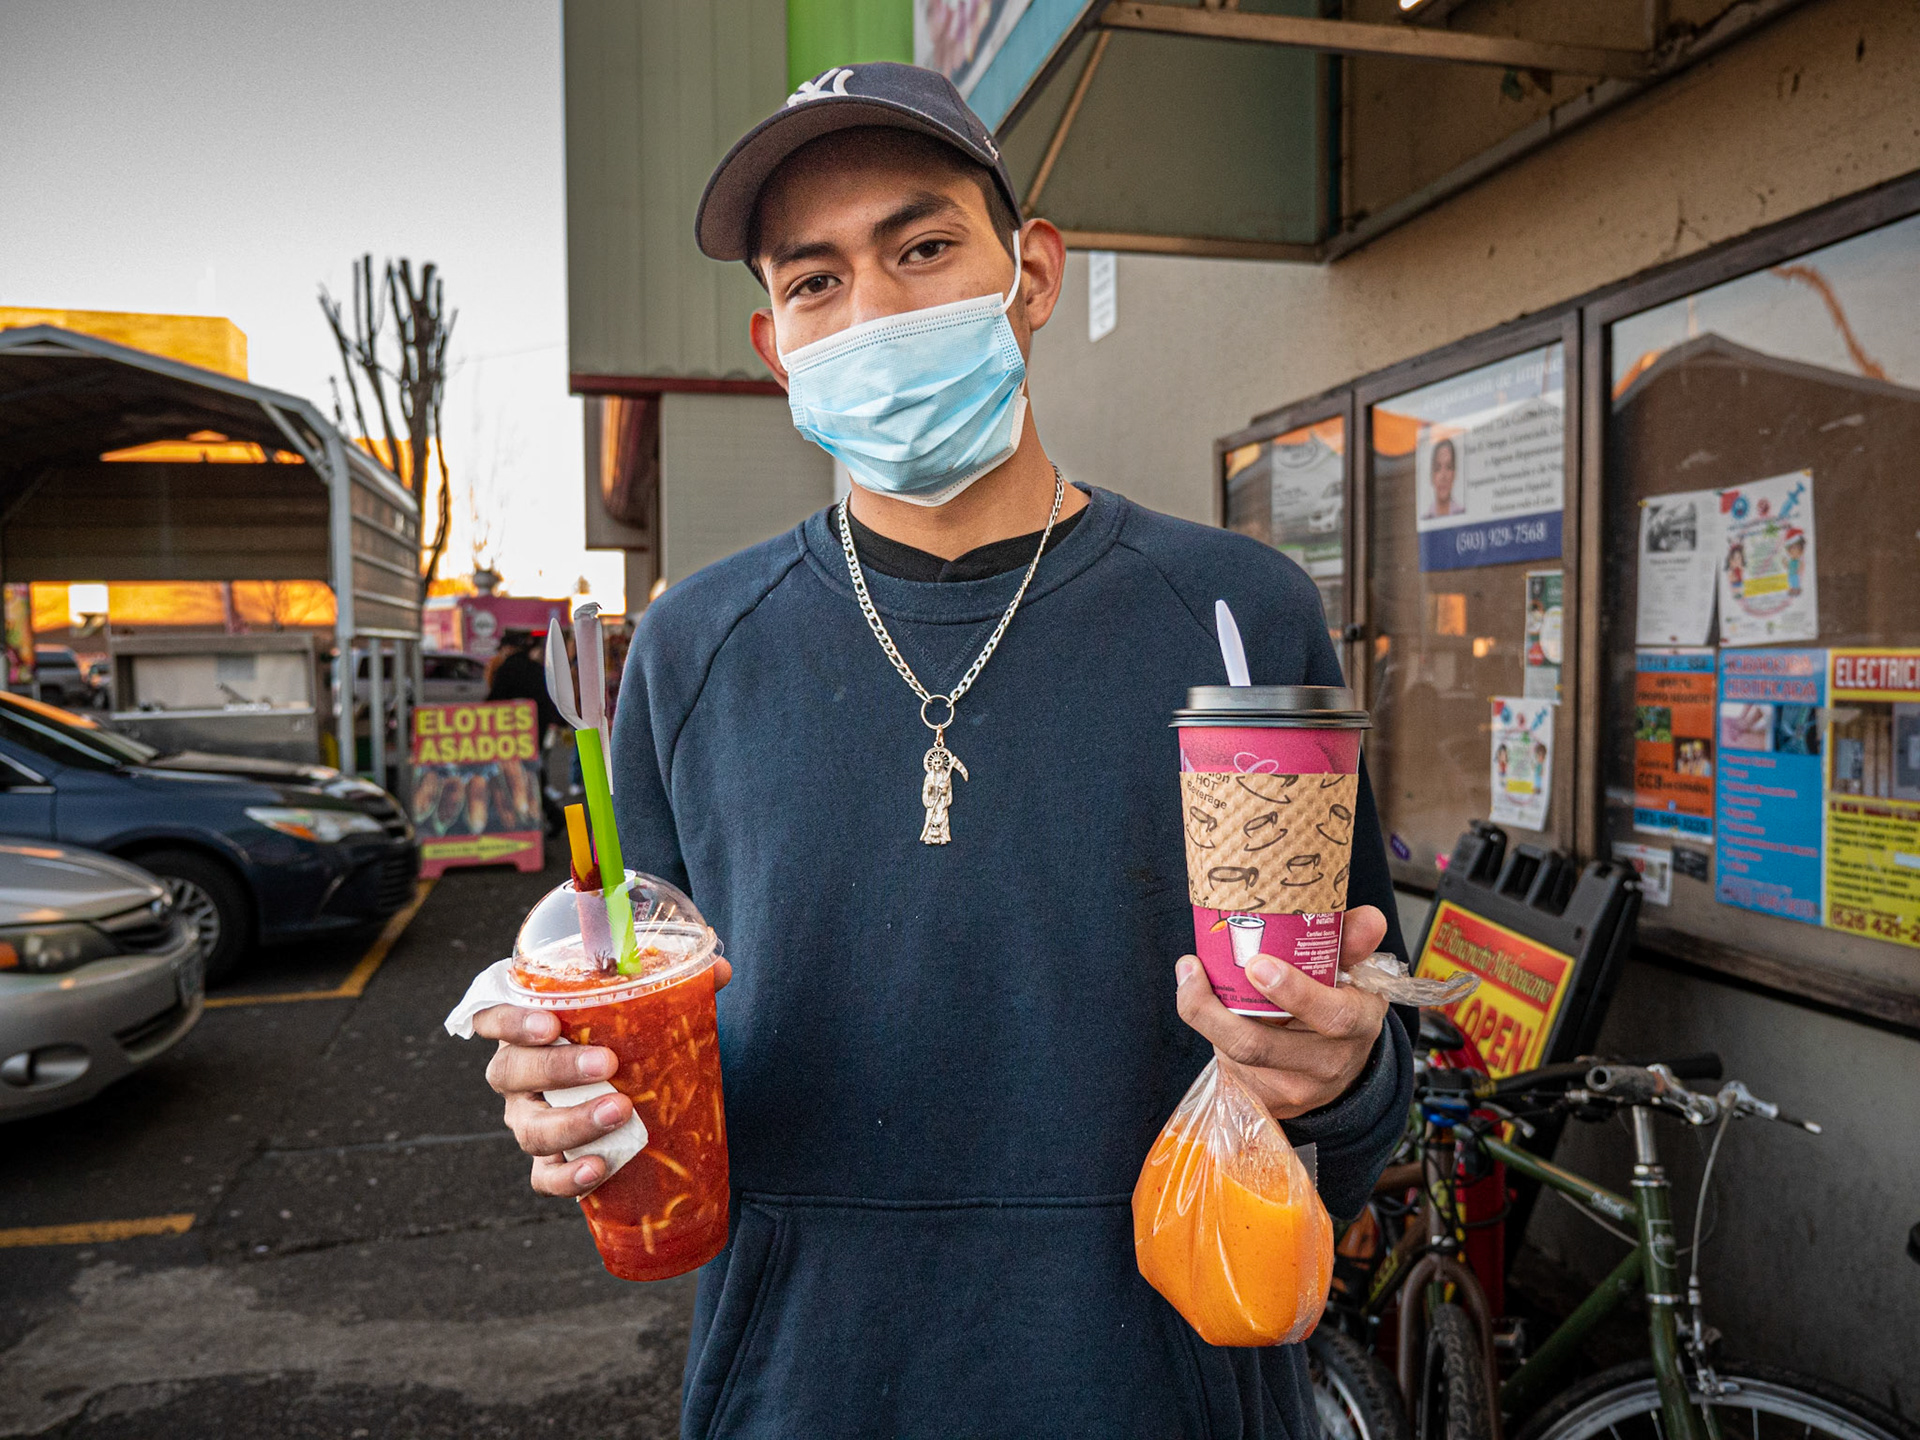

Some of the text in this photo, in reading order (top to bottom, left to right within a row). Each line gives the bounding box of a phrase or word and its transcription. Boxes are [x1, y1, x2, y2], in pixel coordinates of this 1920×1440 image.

[1456, 522, 1546, 555] (503) 929-7568
[417, 704, 534, 736] ELOTES
[418, 733, 535, 764] ASADOS
[1196, 773, 1218, 791] HOT
[1463, 998, 1534, 1076] OPEN
